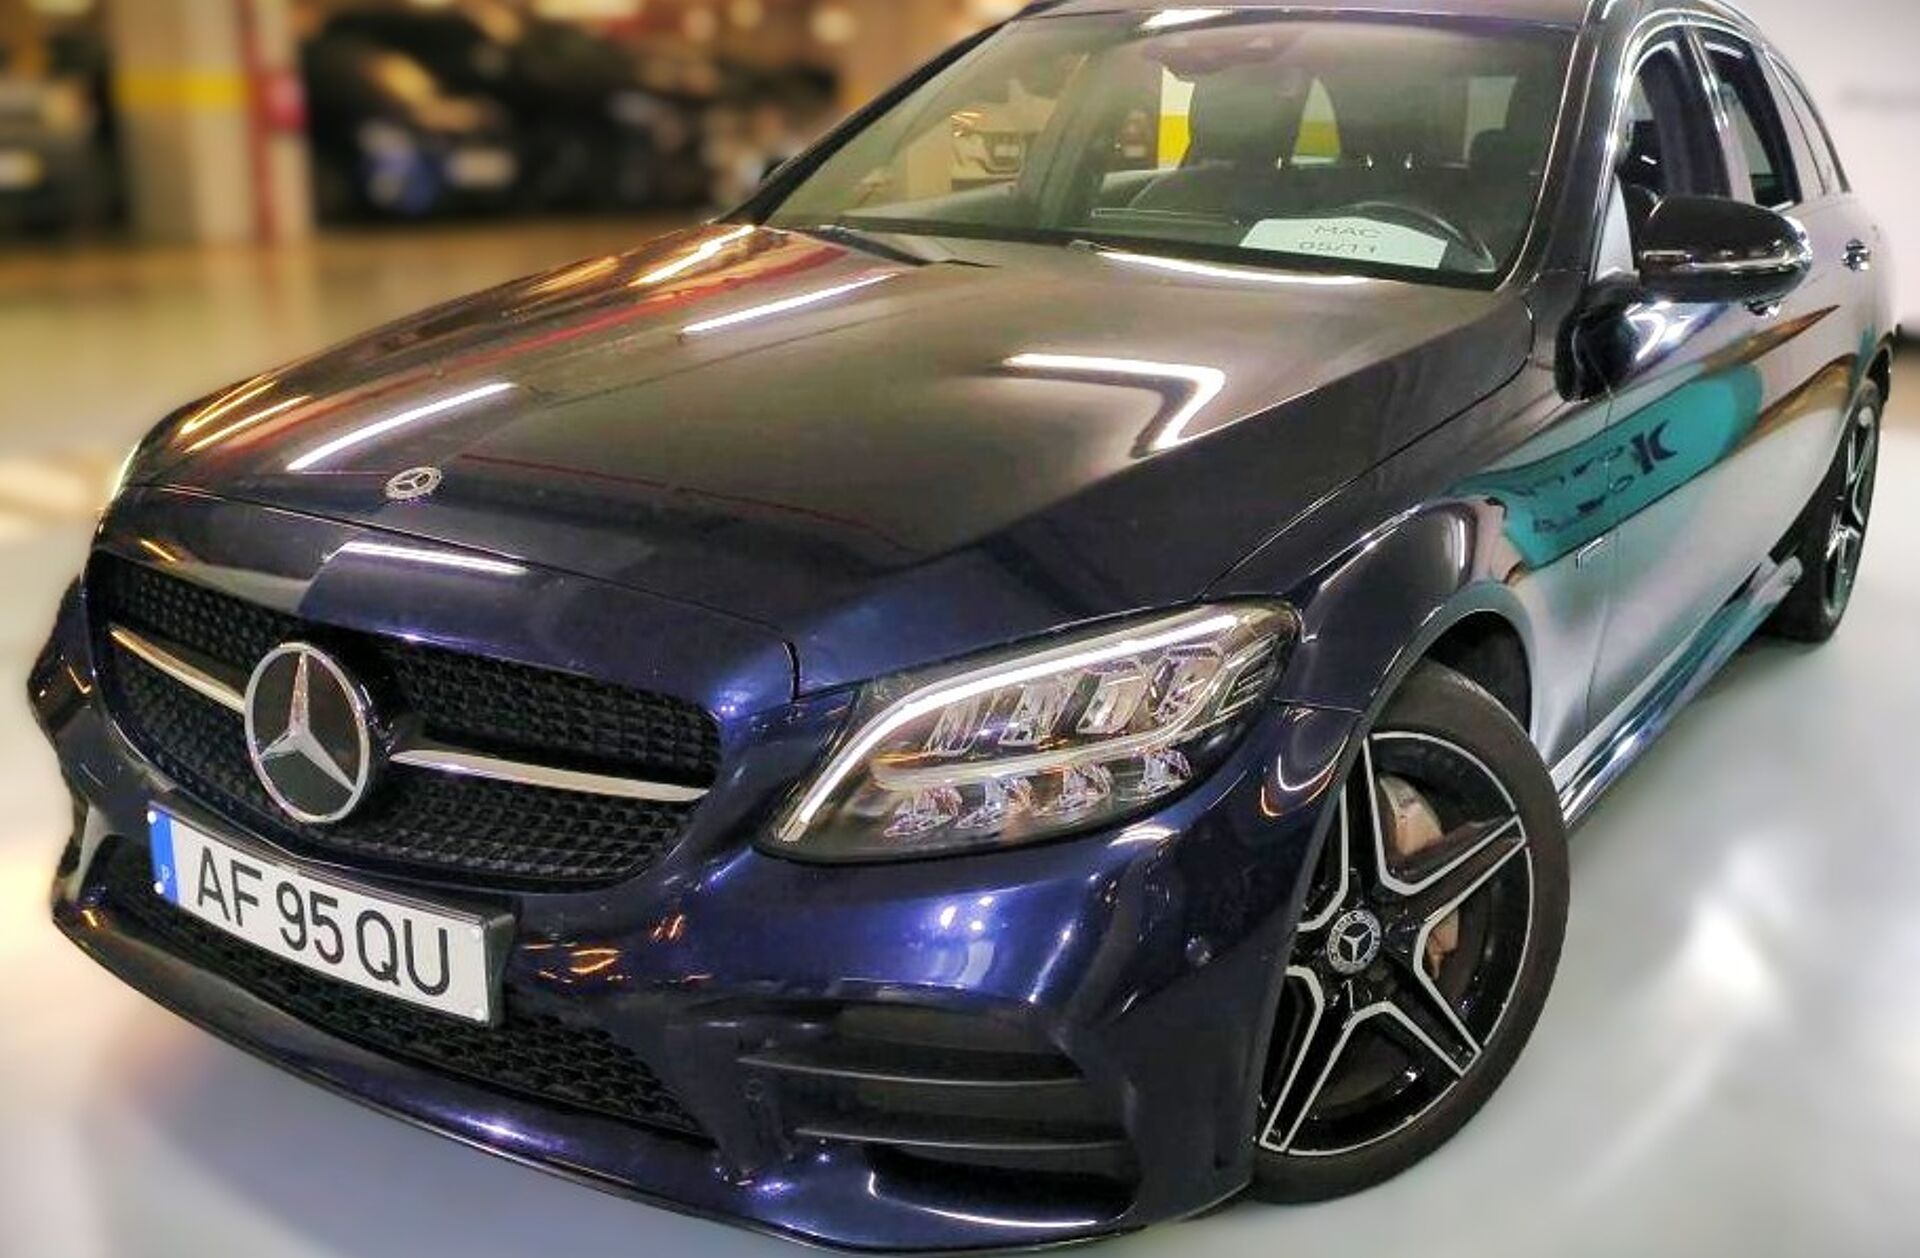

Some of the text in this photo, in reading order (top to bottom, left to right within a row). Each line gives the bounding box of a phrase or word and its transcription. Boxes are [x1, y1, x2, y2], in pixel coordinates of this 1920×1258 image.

[197, 846, 450, 997] AF 95 QU
